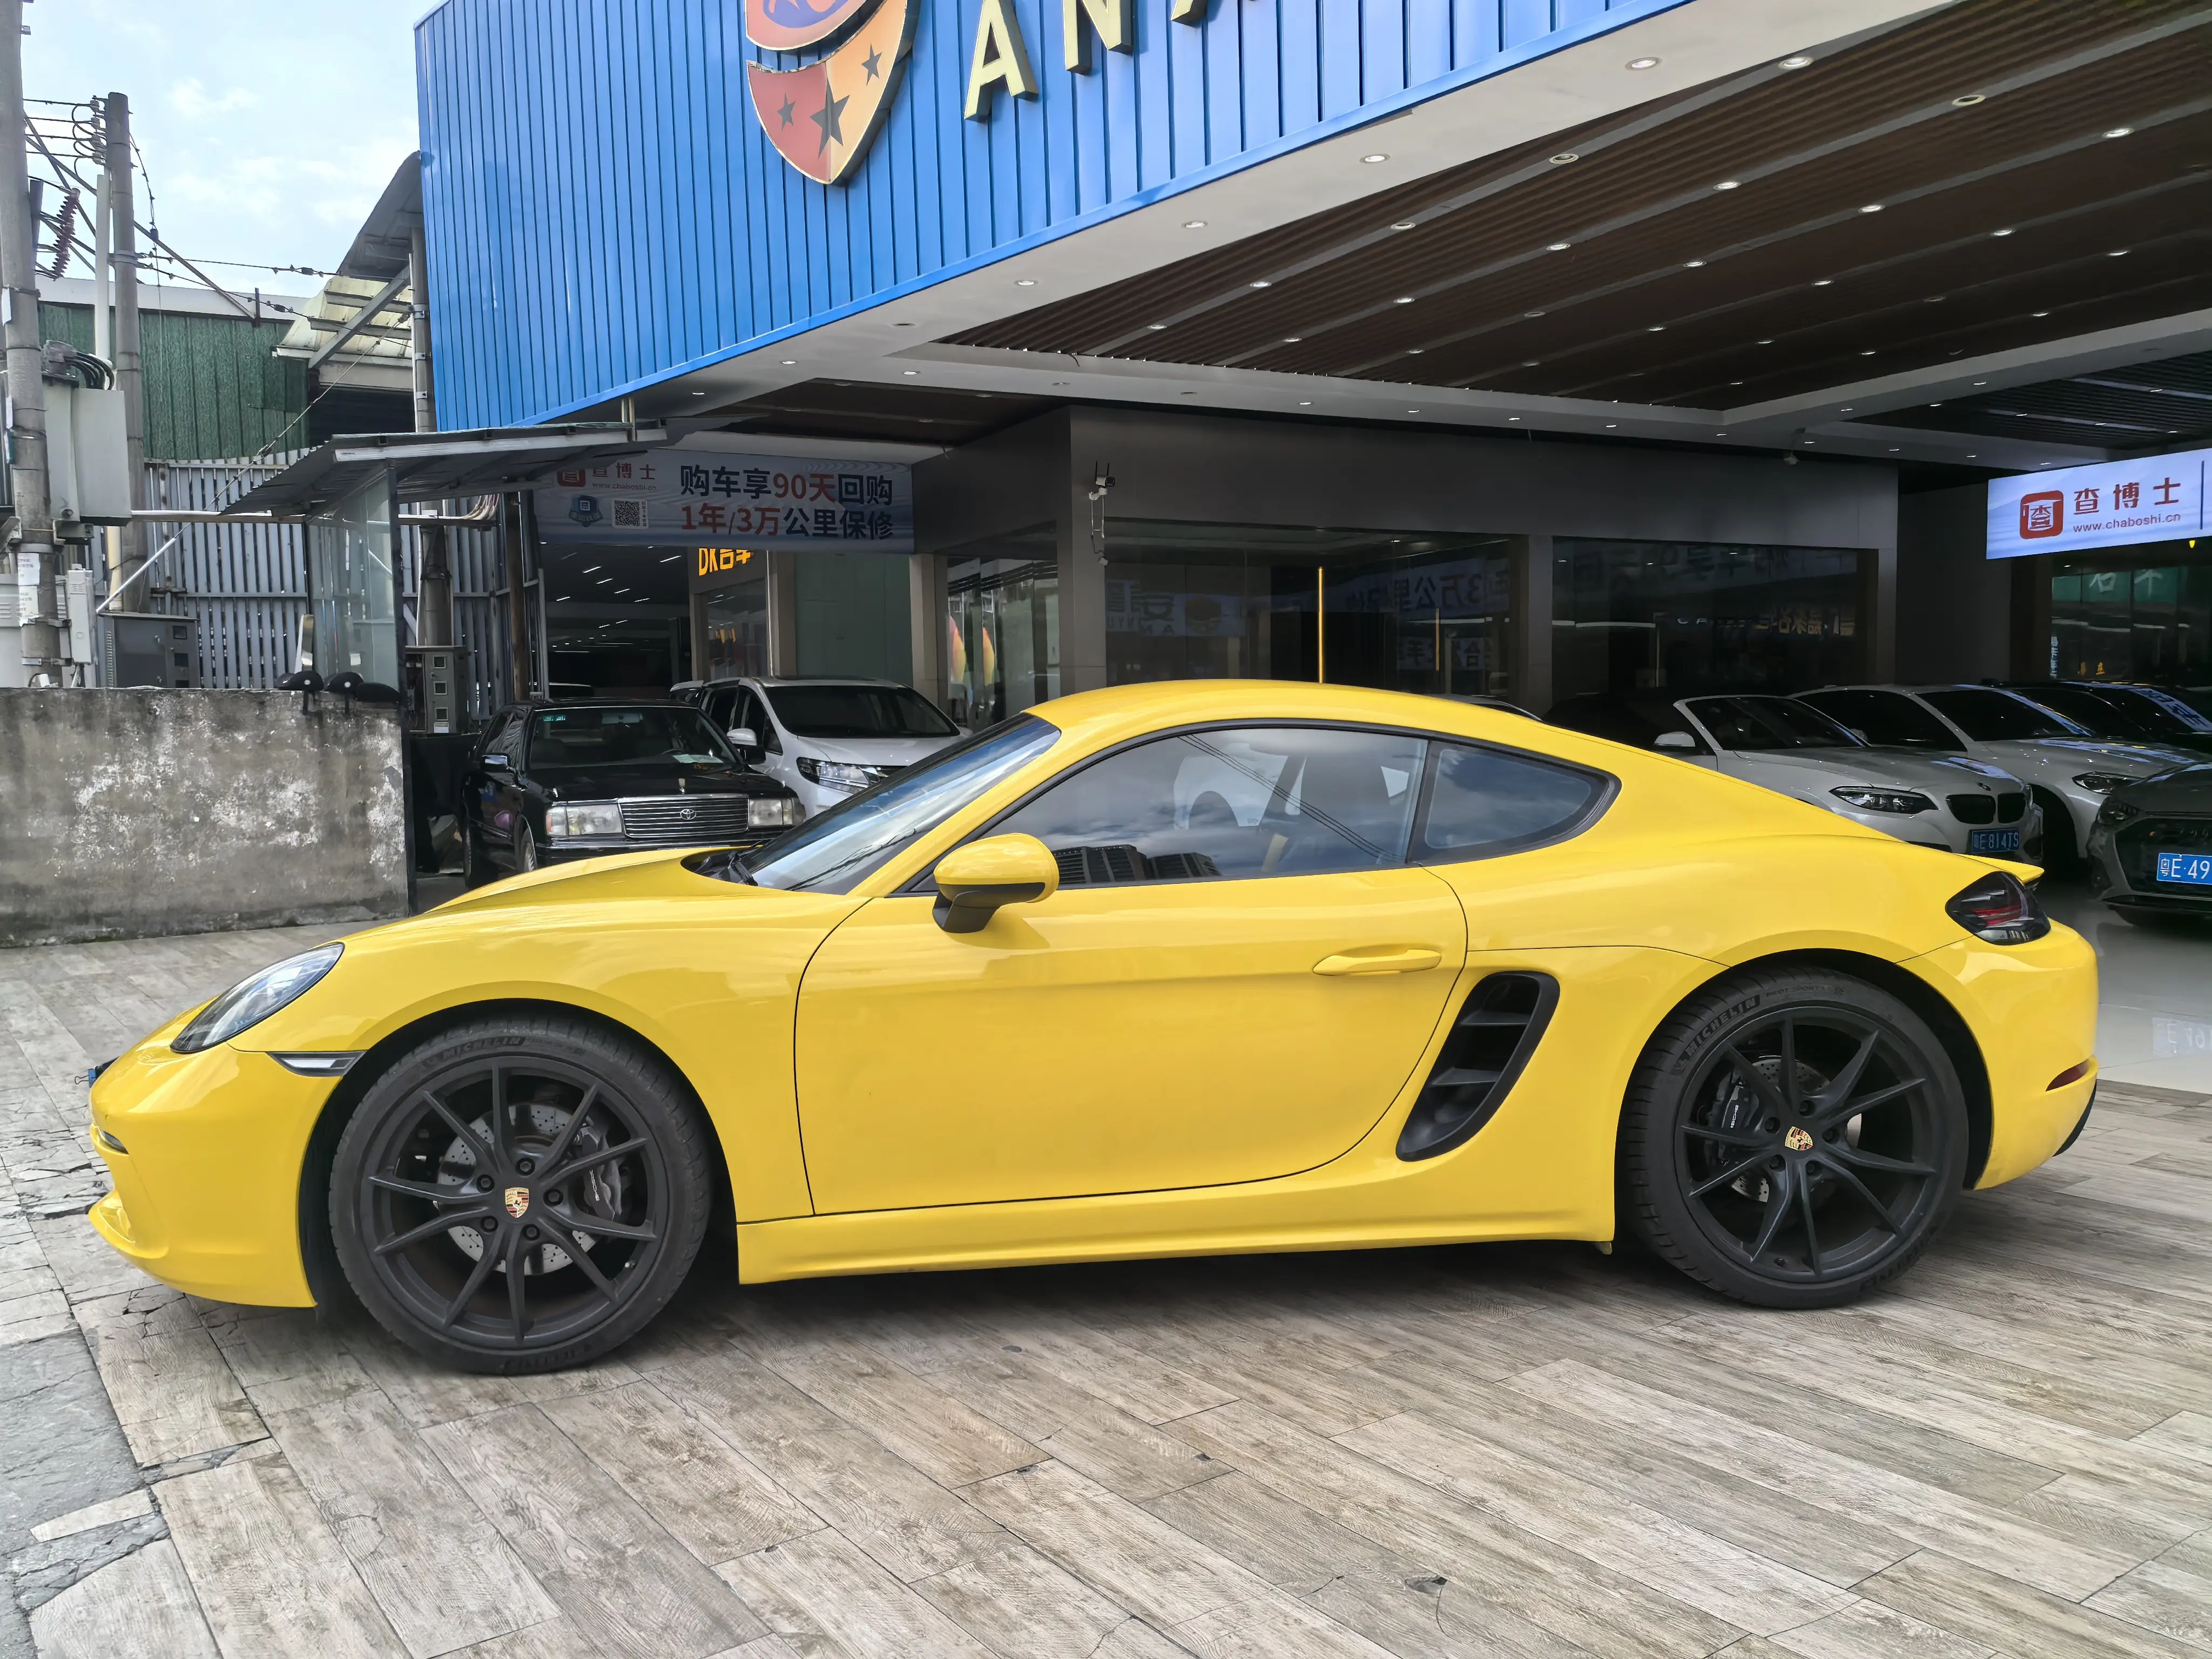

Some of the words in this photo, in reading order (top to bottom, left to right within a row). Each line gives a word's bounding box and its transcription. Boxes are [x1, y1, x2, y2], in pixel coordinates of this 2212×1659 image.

[964, 0, 1209, 122] AN
[680, 464, 893, 505] 购车享90天回购
[2074, 477, 2181, 515] 查博士
[682, 502, 894, 540] 1年/3万公里保修
[2073, 512, 2181, 533] www.chaboshi.cn
[1685, 996, 1757, 1056] MICHELIN
